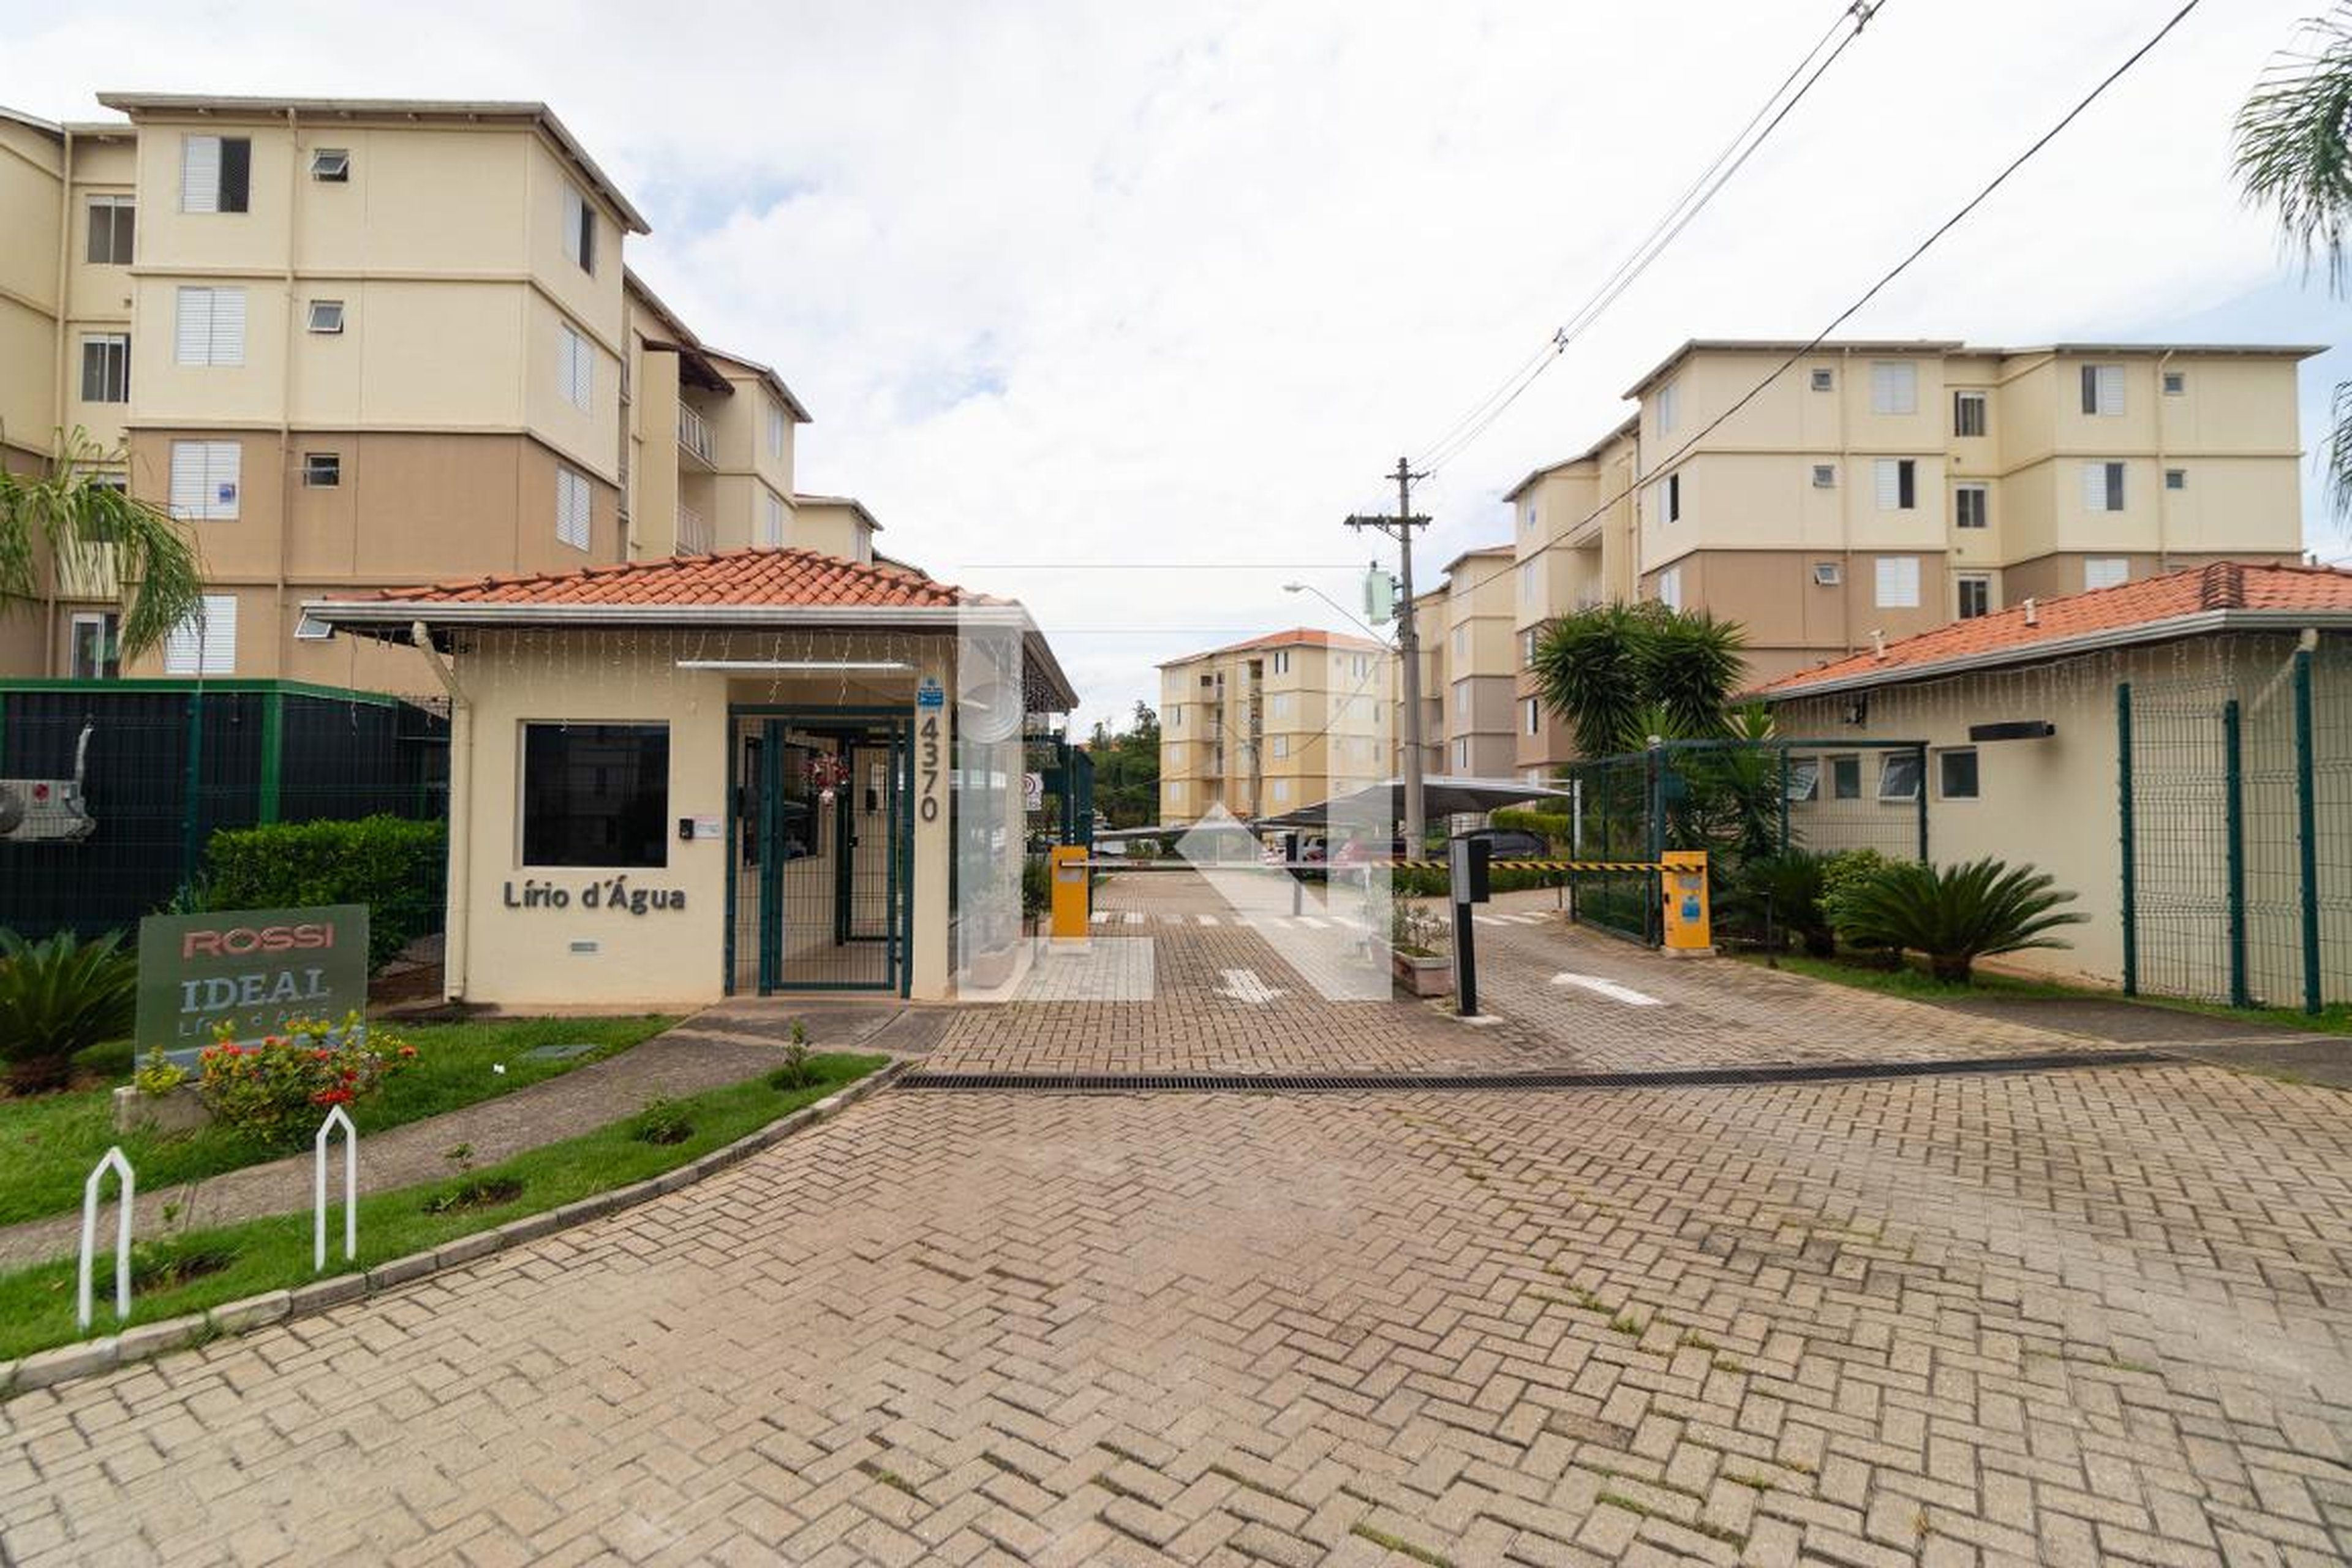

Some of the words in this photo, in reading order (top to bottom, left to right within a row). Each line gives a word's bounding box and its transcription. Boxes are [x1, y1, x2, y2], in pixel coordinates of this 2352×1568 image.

[921, 716, 939, 822] 4370
[503, 879, 570, 908] Lírio
[182, 923, 335, 959] ROSSI
[180, 968, 330, 1013] IDEAL
